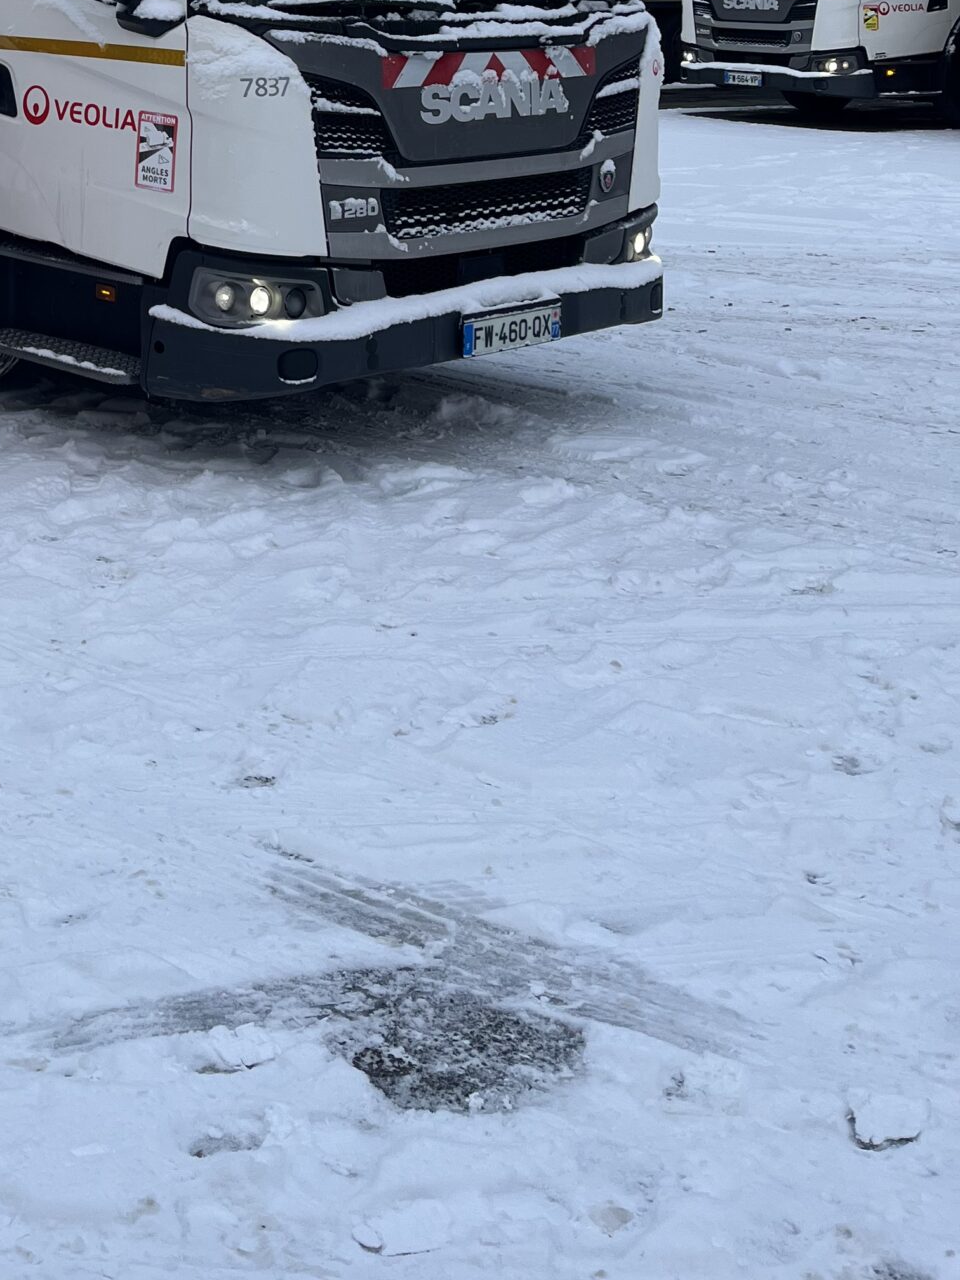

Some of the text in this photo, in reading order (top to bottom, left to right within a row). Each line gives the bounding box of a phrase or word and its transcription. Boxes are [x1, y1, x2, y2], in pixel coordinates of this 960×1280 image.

[891, 3, 925, 13] VEOLIA
[239, 76, 290, 98] 7837
[420, 76, 567, 125] SCANIA
[53, 98, 137, 132] VEOLIA
[141, 112, 176, 125] ATTENTION
[141, 165, 169, 178] ANGLES
[142, 174, 168, 186] MORTS
